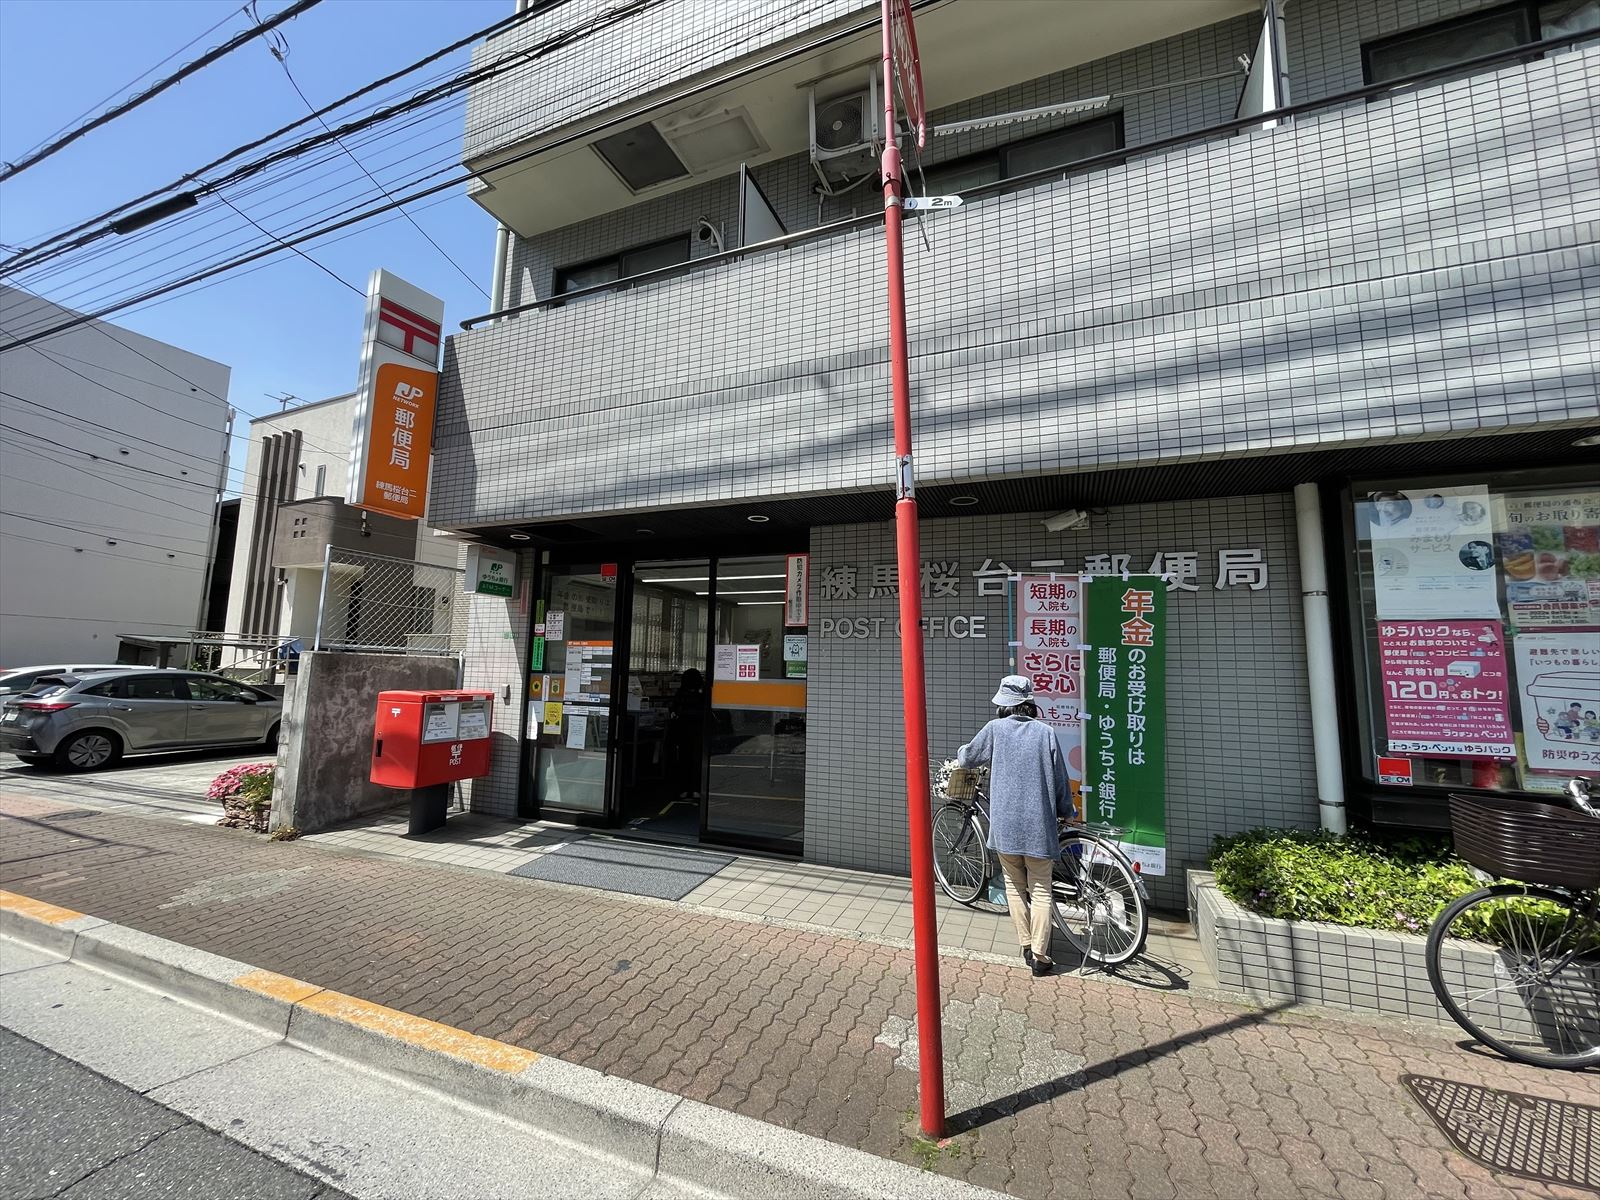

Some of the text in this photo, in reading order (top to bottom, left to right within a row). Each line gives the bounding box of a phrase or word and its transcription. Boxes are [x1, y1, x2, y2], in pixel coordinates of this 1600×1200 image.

[931, 197, 953, 207] 2m
[392, 395, 420, 409] NETWORK
[388, 407, 414, 470] 郵便局
[375, 480, 417, 498] 練馬桜台二
[383, 492, 409, 505] 郵便局
[1410, 543, 1454, 553] サービス
[1030, 583, 1077, 600] 短期の
[1037, 601, 1070, 612] 入院も
[820, 616, 987, 639] POST FICE
[1030, 619, 1077, 636] 長期の
[1037, 637, 1070, 648] 入院も
[1024, 652, 1081, 673] さらに
[1032, 673, 1077, 695] 安心
[1121, 588, 1155, 766] 年金のお受け取りは
[449, 758, 462, 766] POST
